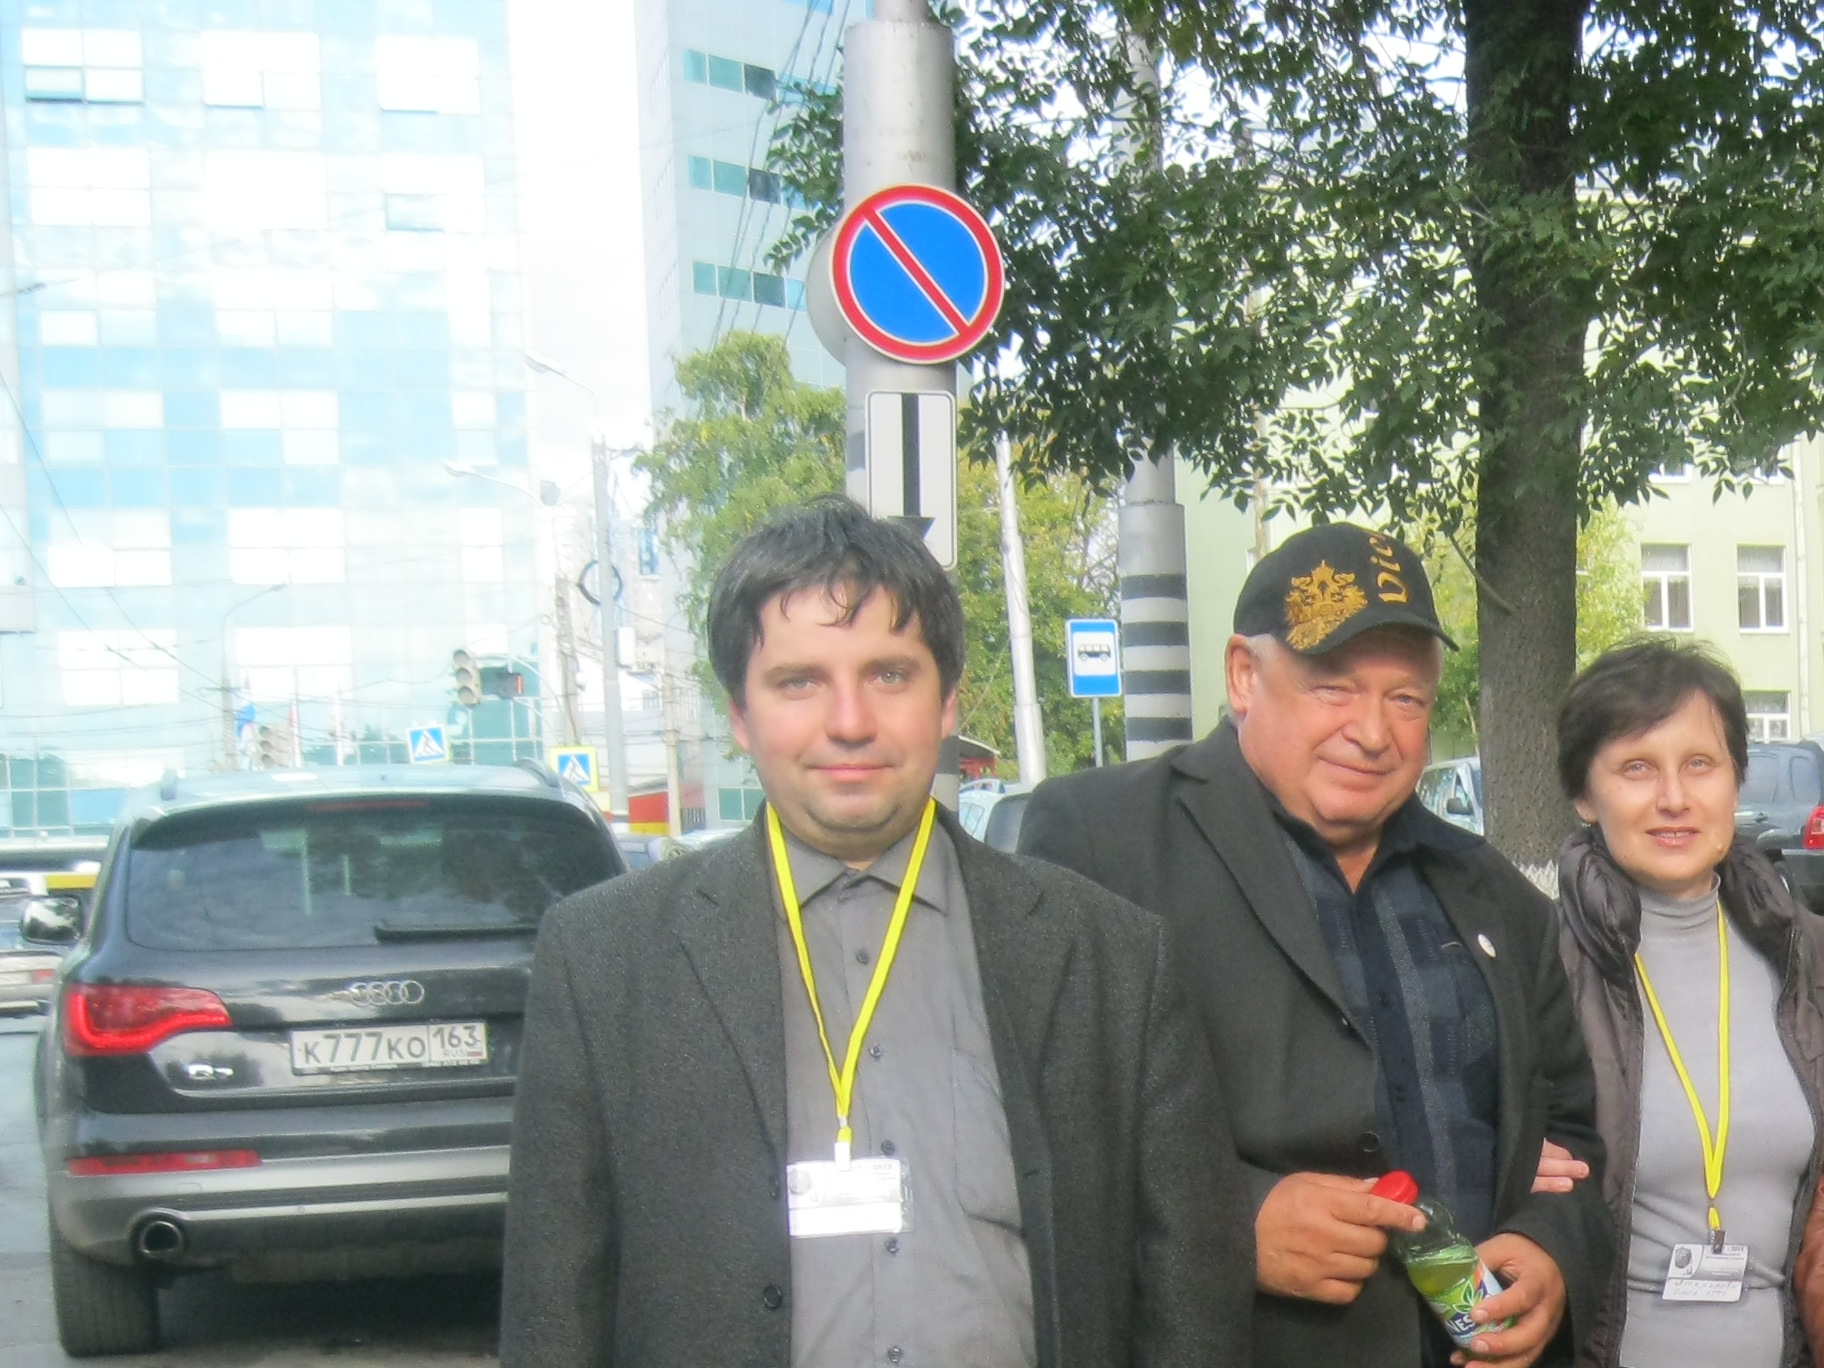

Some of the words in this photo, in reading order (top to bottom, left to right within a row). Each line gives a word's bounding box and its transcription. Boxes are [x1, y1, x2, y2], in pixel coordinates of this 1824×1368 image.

[432, 1025, 481, 1049] 163
[443, 1050, 467, 1058] RUS
[1445, 1314, 1477, 1333] NES
